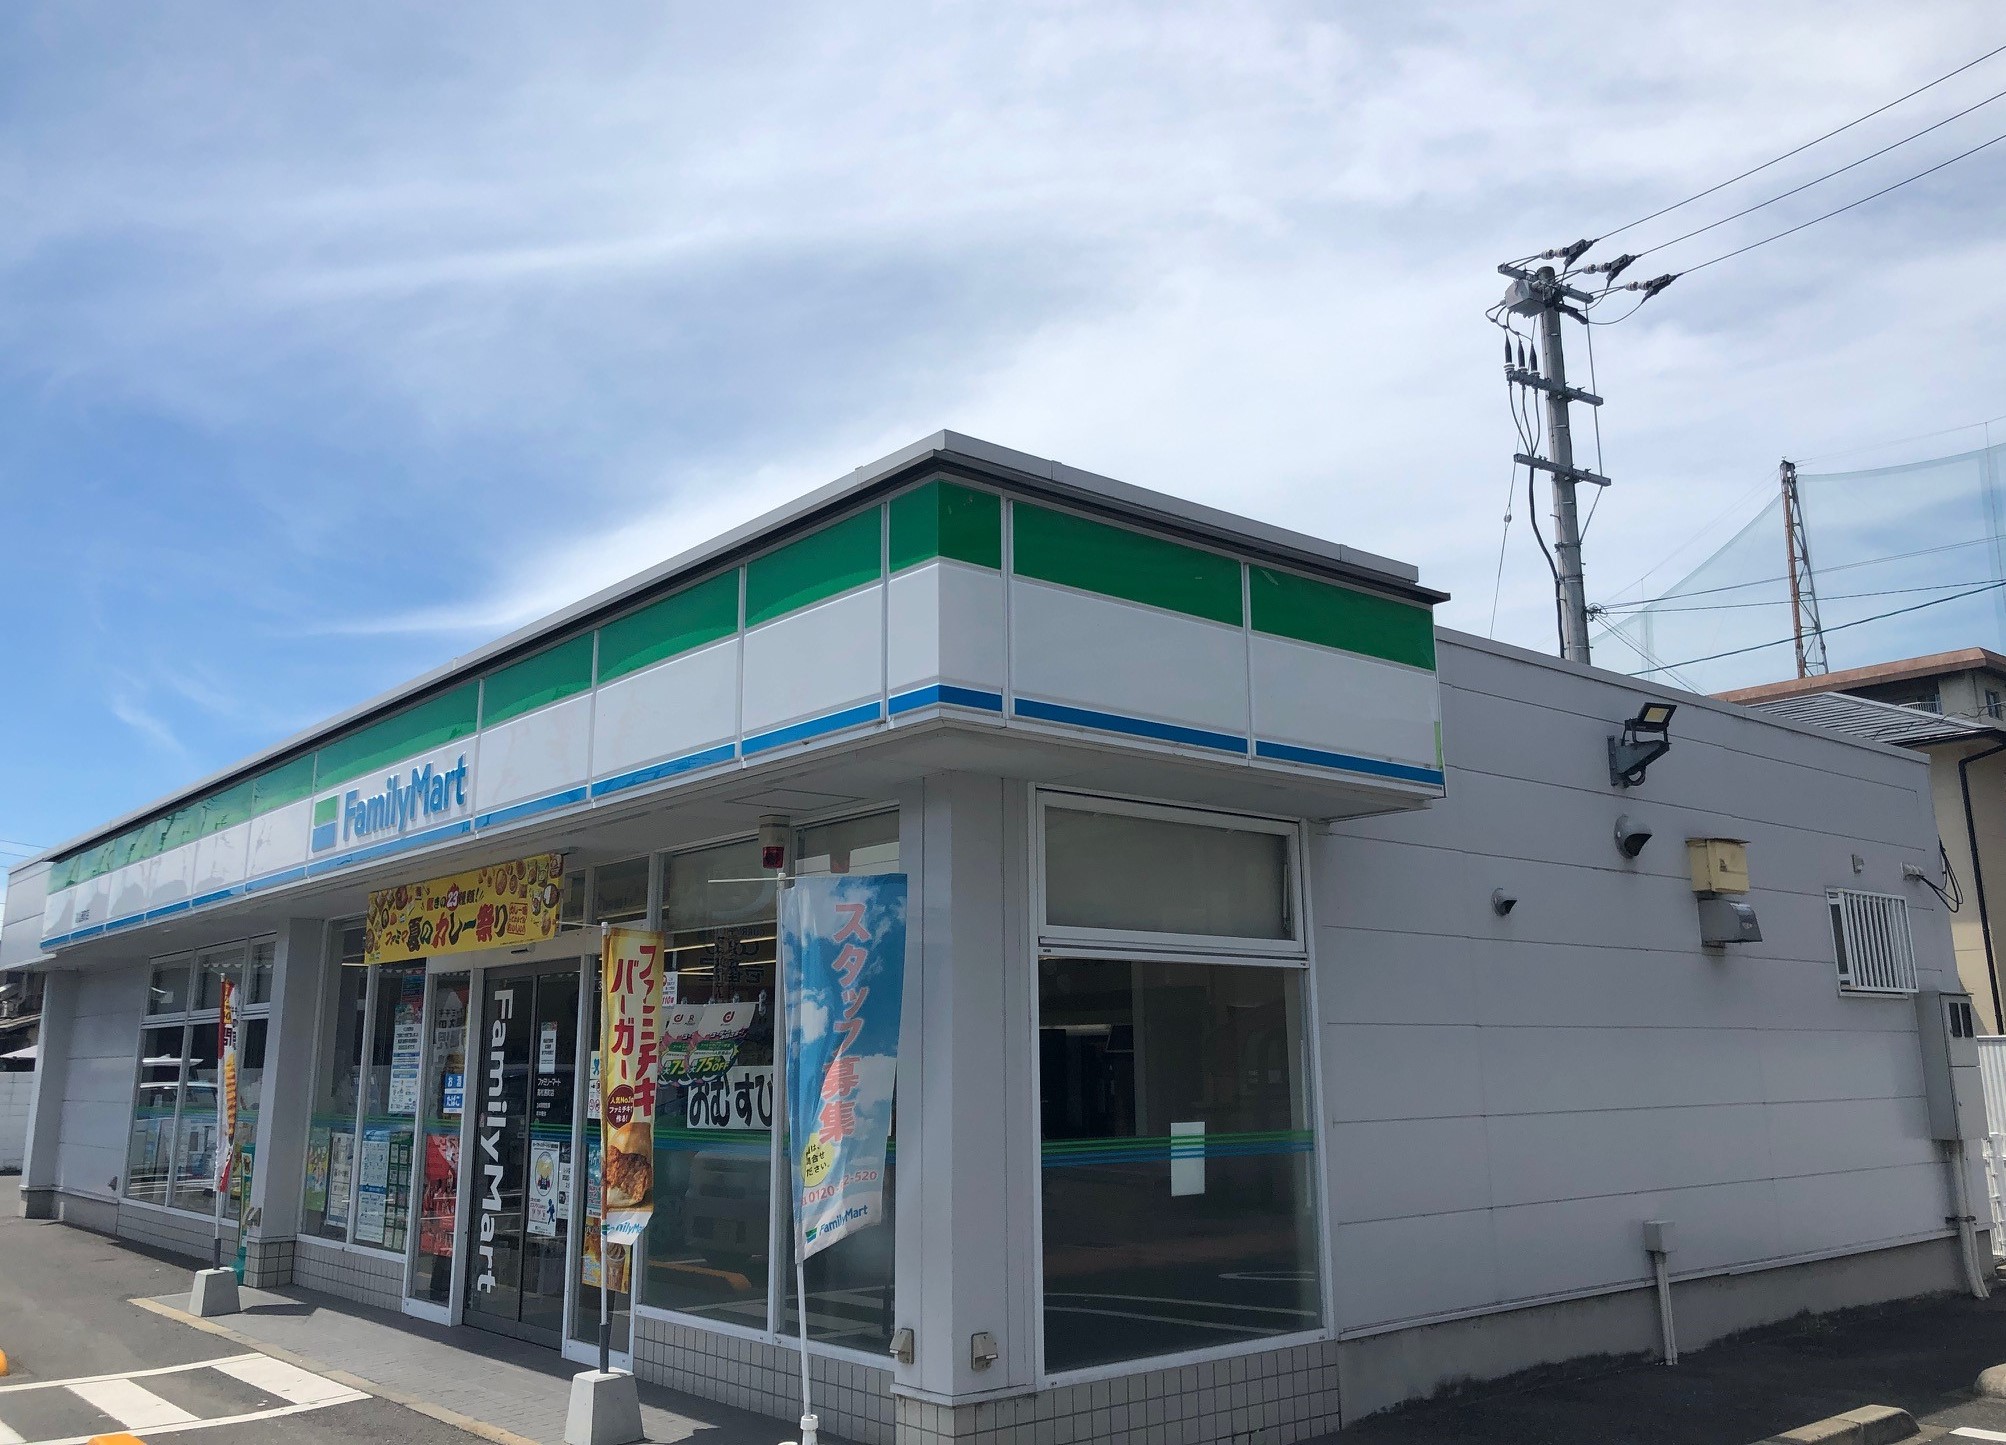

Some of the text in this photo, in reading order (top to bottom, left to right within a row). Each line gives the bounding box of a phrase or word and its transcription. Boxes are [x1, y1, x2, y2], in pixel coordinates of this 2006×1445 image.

[343, 751, 467, 841] FamilyMart
[610, 958, 639, 1080] バーガー
[633, 945, 657, 1117] ファミチキ
[818, 902, 871, 1145] スタッフ募集
[477, 989, 514, 1294] FamilyMart
[537, 1078, 561, 1087] ファミリーマート
[819, 1205, 868, 1237] FamilyMart
